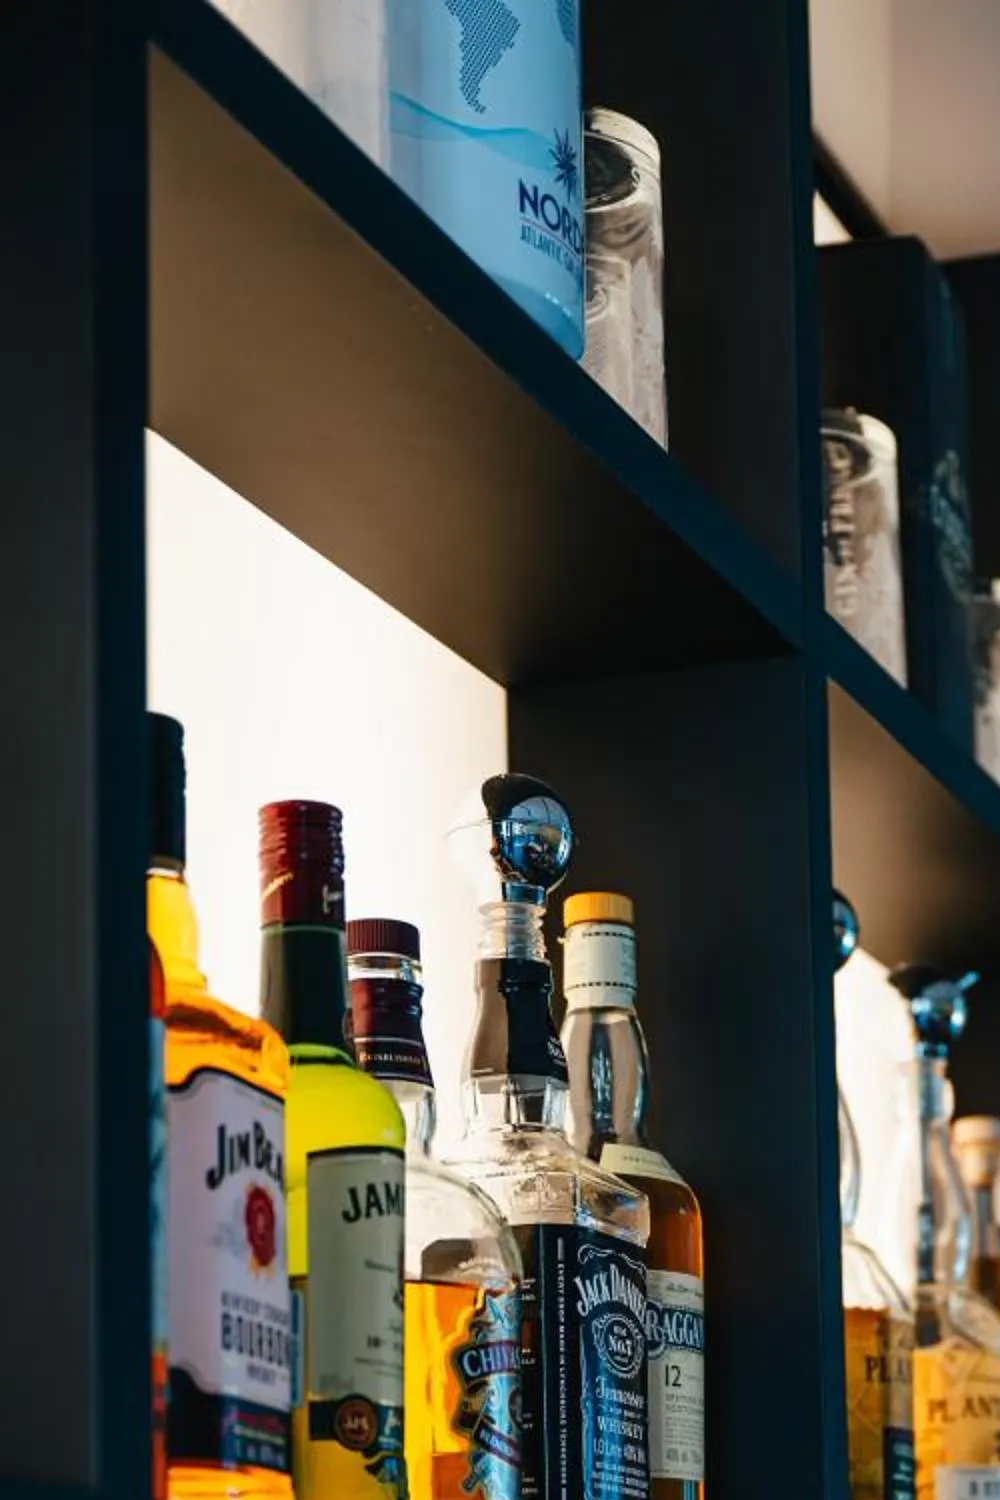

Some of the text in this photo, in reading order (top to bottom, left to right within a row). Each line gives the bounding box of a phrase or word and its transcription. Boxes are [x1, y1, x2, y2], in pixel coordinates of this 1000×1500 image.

[206, 1124, 250, 1191] JIM
[573, 1270, 612, 1317] JACK
[665, 1363, 683, 1388] 12
